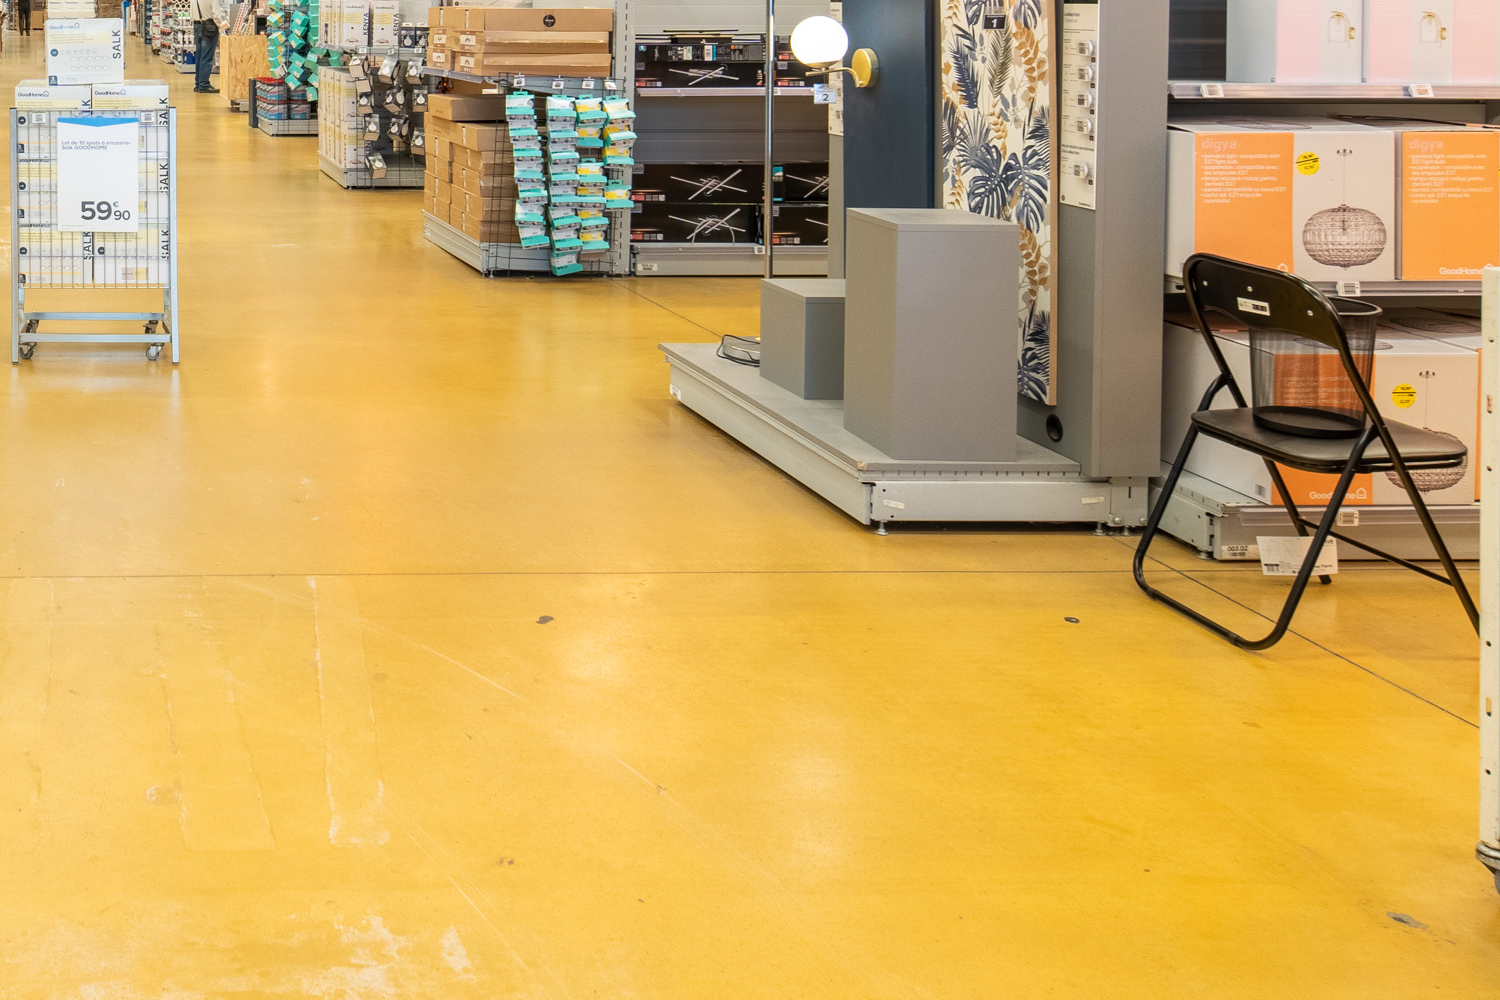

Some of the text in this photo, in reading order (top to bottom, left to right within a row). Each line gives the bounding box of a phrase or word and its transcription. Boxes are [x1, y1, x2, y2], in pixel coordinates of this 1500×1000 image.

[392, 13, 400, 37] KENYA
[111, 30, 122, 59] SALK
[822, 94, 829, 102] 2
[1201, 139, 1237, 152] digya
[1409, 138, 1444, 152] digya
